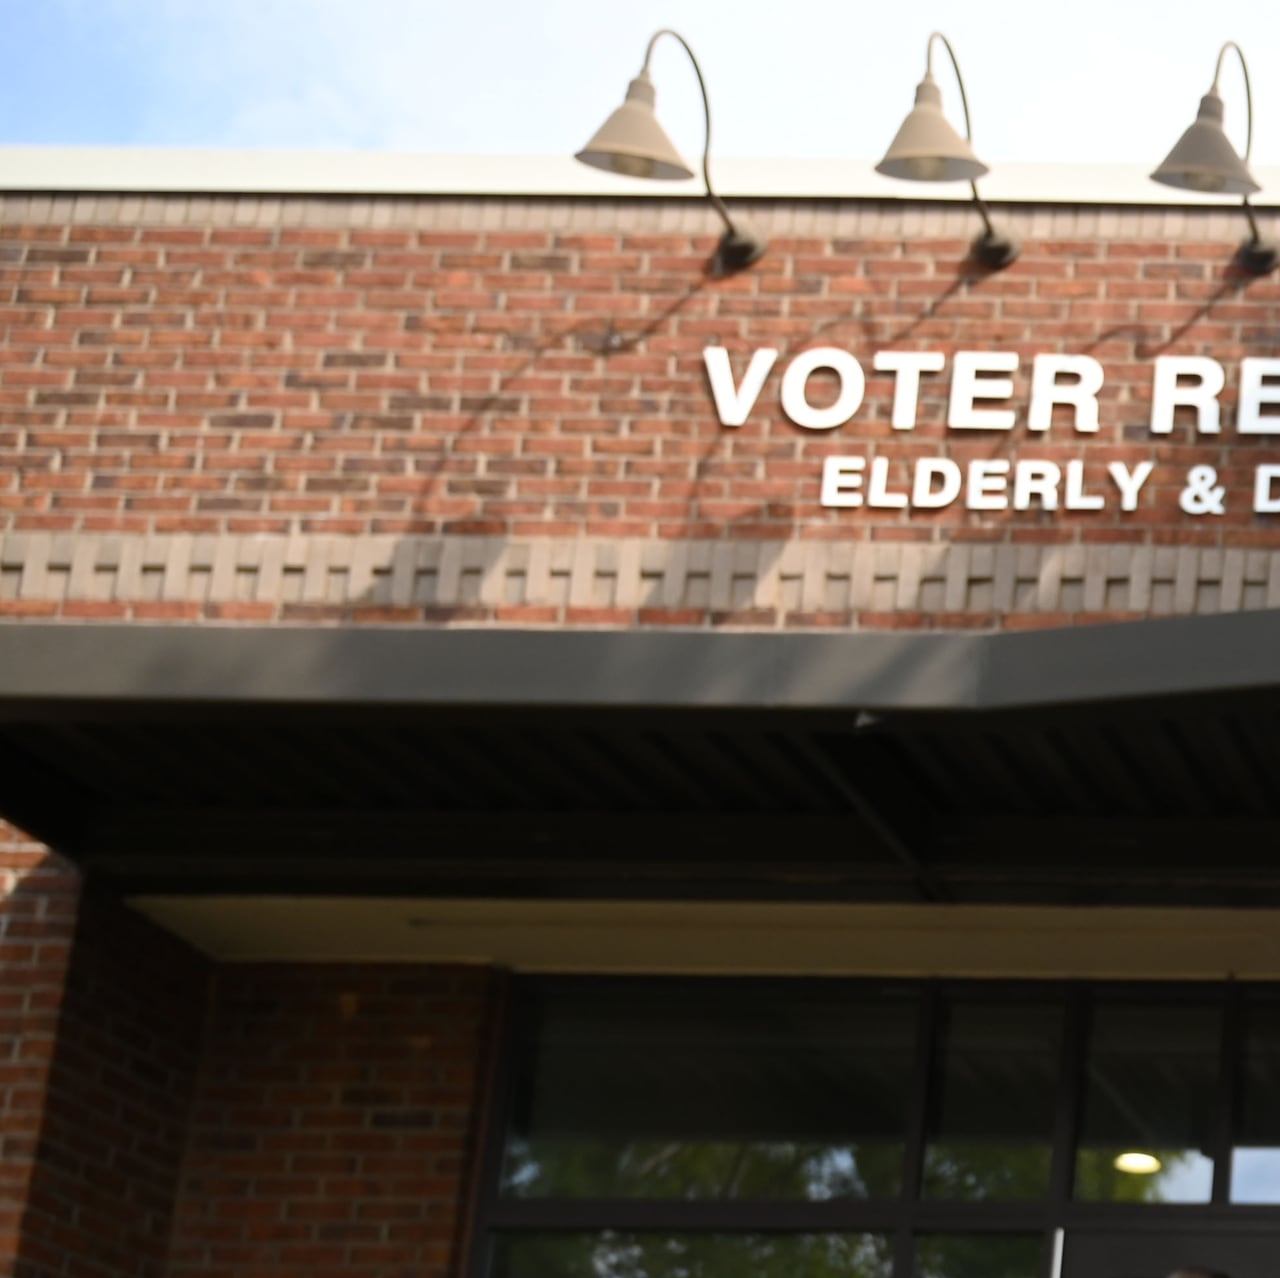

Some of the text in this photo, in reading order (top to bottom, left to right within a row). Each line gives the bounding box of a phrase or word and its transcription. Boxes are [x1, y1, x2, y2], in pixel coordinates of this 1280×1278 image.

[702, 346, 1105, 432] VOTER
[819, 455, 1155, 512] ELDERLY
[1179, 464, 1226, 515] &
